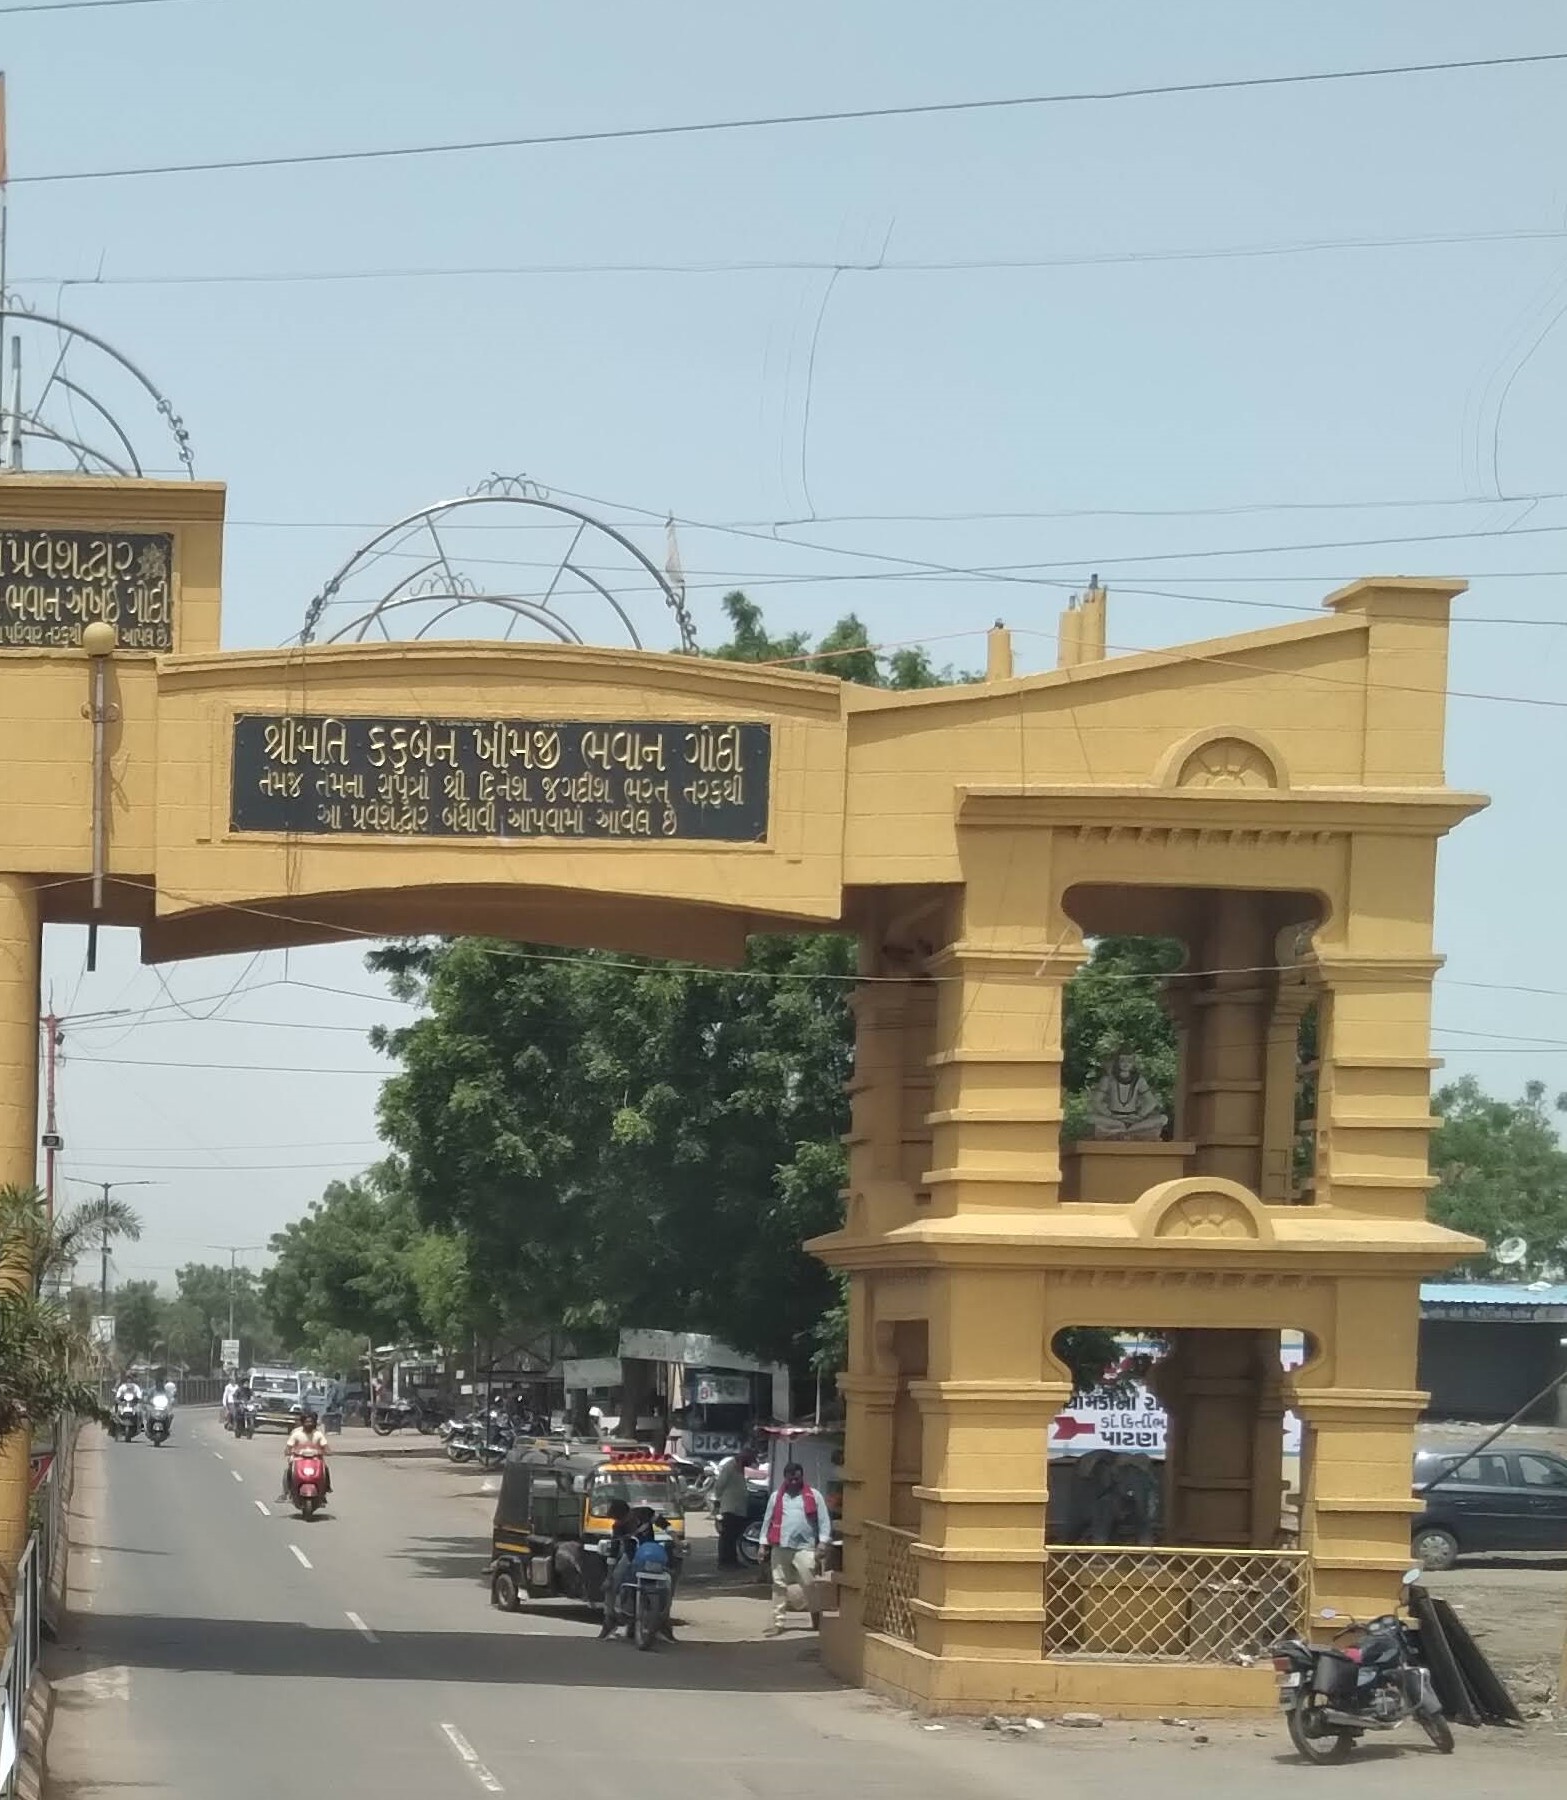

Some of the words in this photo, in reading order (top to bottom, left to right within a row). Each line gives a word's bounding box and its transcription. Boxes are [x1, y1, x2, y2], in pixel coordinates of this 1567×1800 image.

[5, 584, 62, 622] ભવાન
[263, 717, 350, 765] શ્રીમતિ
[472, 721, 562, 770] ખીમજી
[580, 730, 666, 772] ભવાન
[258, 766, 304, 798] તેમજ
[315, 767, 365, 799] તેમના
[376, 769, 431, 804] સુપુત્રો
[442, 769, 470, 802] શ્રી
[478, 769, 533, 802] દિનેશ
[541, 771, 614, 804] જગદીશ
[622, 776, 671, 805] ભરત
[682, 774, 745, 810] તરફથી
[315, 803, 341, 830] આ
[441, 800, 497, 832] બંધાવી
[507, 805, 585, 833] આપવામાં
[595, 804, 651, 835] આવેલ
[661, 804, 678, 836] છે
[1100, 1431, 1158, 1448] પાટણ
